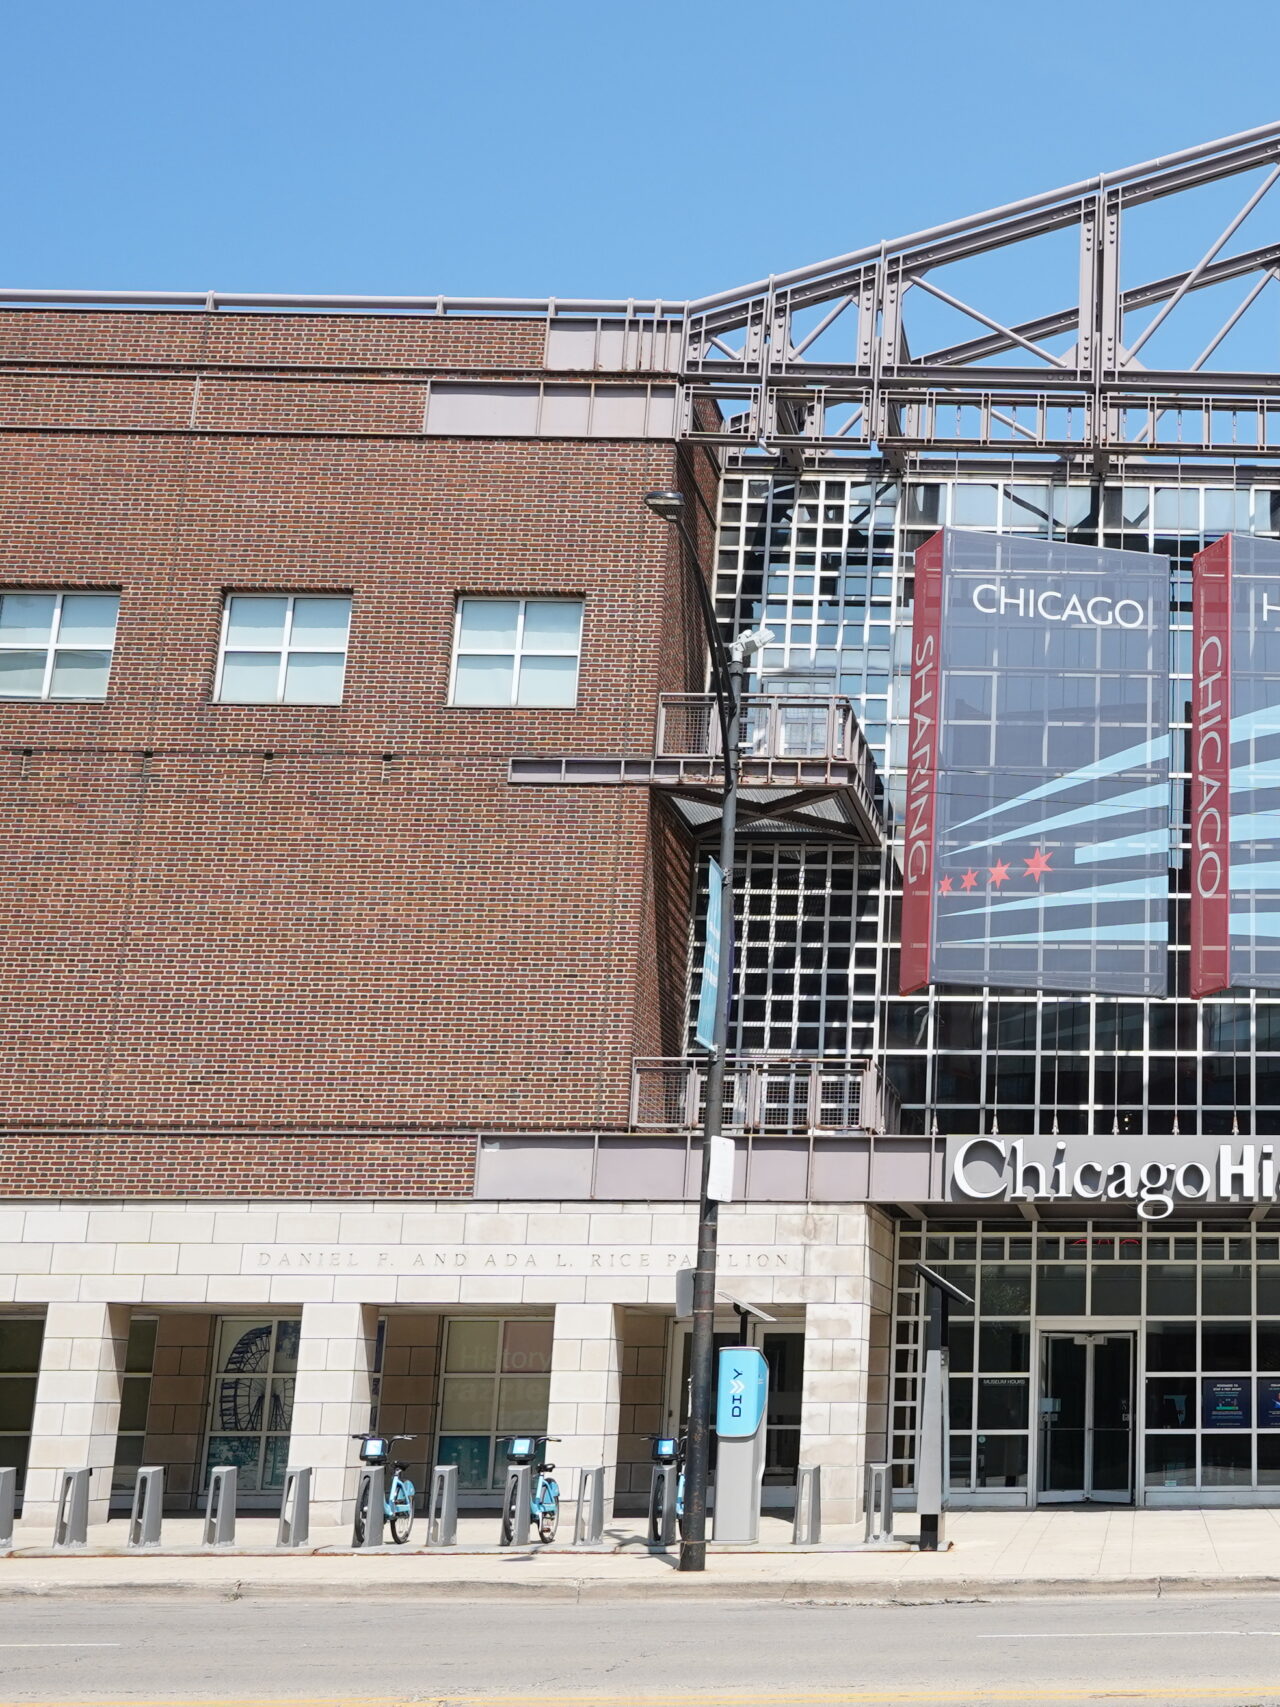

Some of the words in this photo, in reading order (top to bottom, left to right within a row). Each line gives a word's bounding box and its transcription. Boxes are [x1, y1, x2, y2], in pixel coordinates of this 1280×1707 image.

[971, 583, 1145, 629] CHICAGO
[907, 635, 934, 884] SHARING
[1196, 636, 1223, 898] CHICAGO
[952, 1137, 1211, 1220] Chicago
[257, 1252, 360, 1267] DANIEL
[377, 1252, 394, 1267] F.
[412, 1252, 468, 1267] AND
[484, 1252, 537, 1267] ADA
[556, 1253, 574, 1267] L.
[591, 1253, 651, 1267] RICE
[666, 1253, 789, 1268] PAILION
